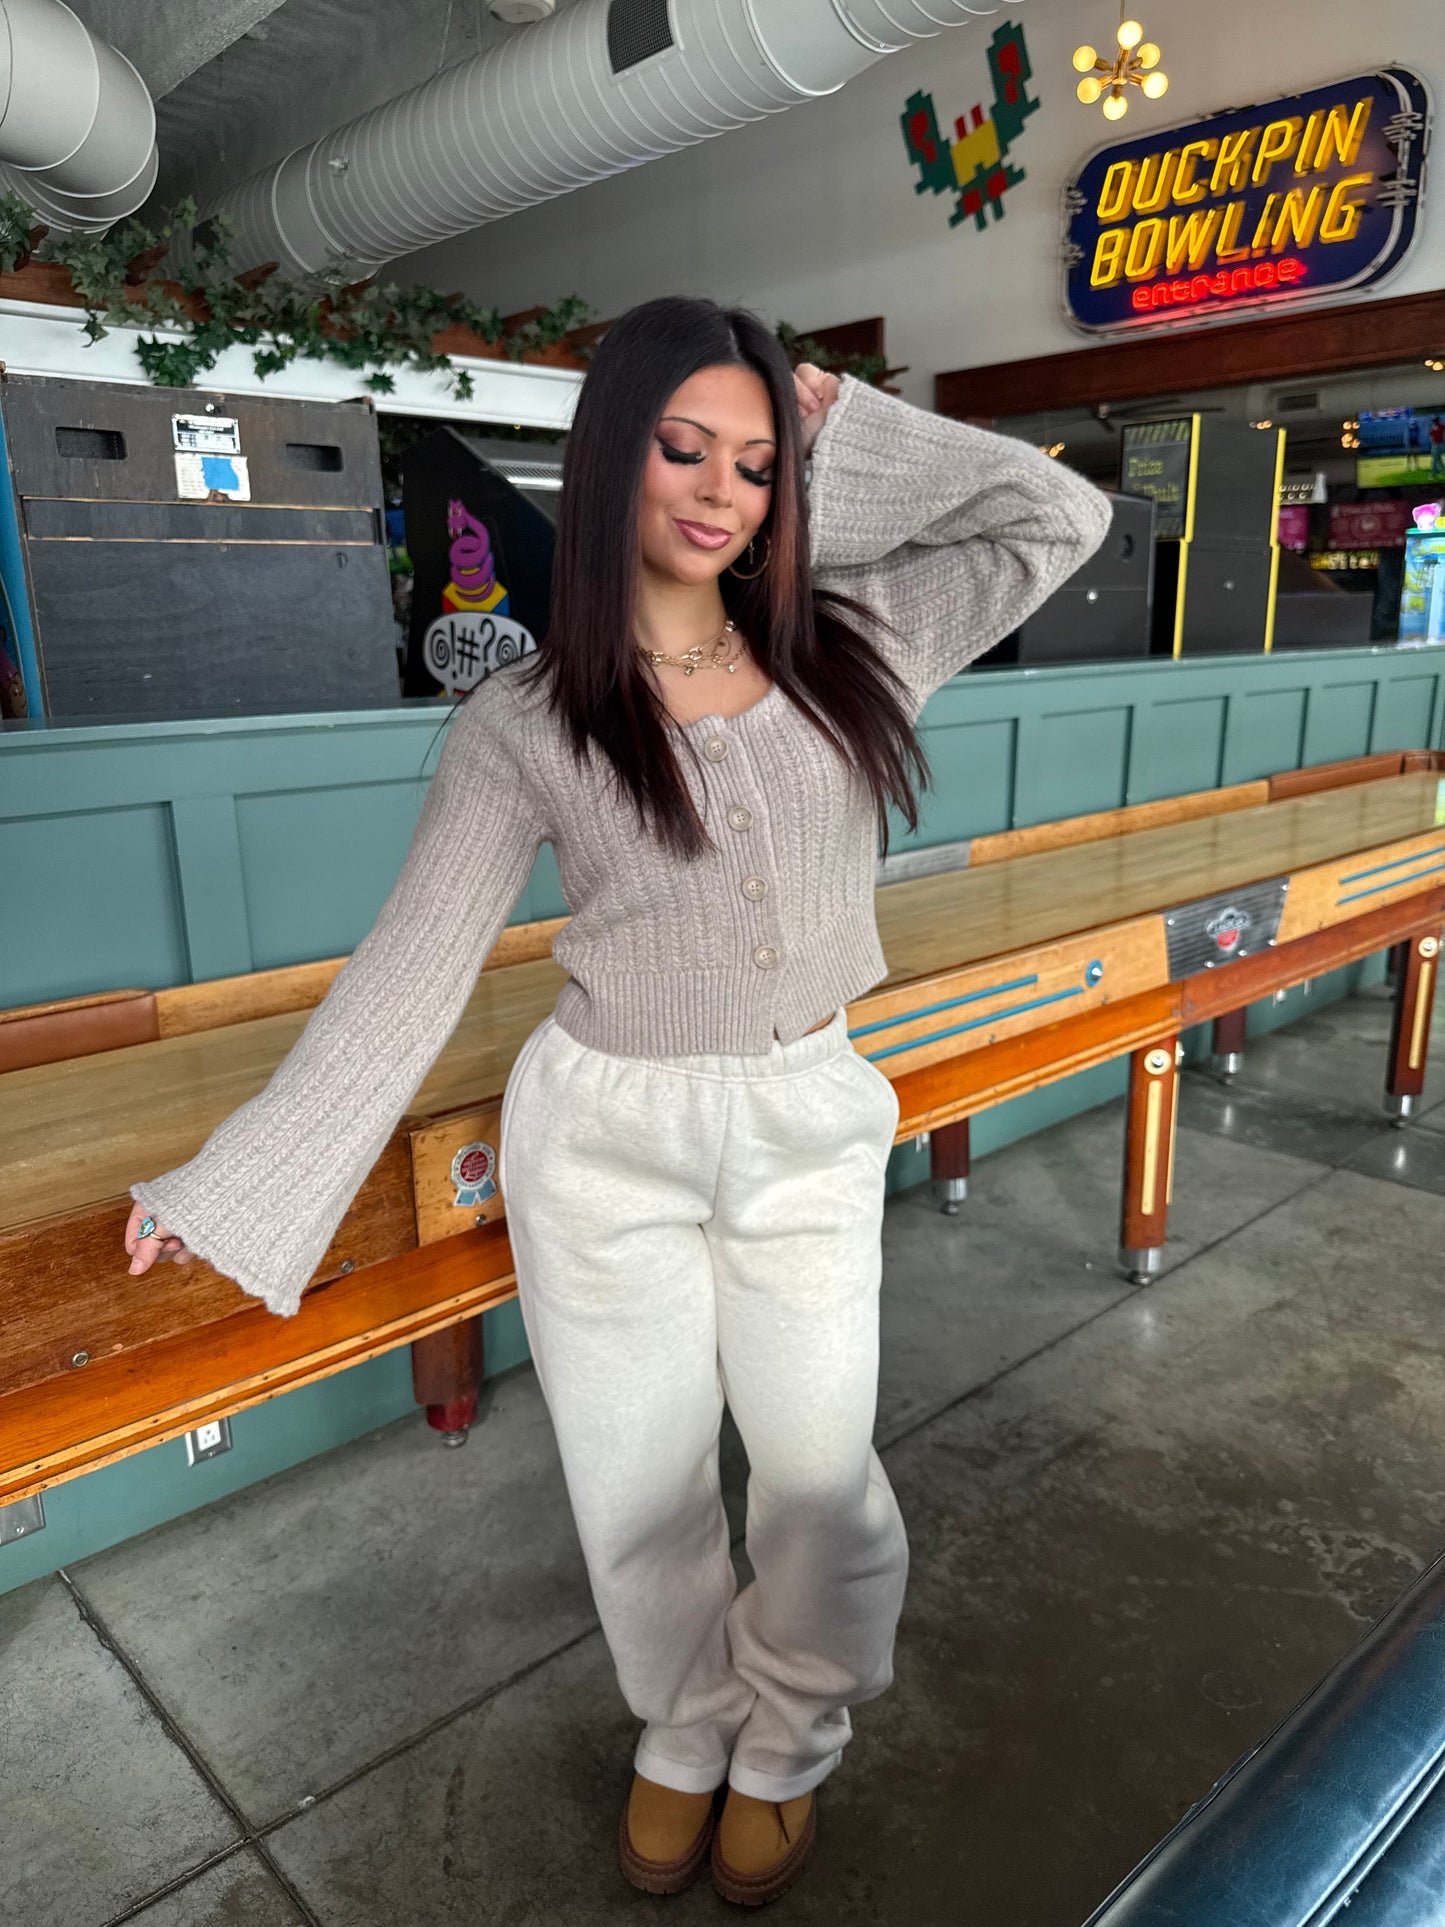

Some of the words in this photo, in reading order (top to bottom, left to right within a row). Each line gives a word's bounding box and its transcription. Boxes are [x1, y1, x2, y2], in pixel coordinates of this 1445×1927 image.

[1097, 97, 1373, 224] DUCKPIN
[1090, 174, 1373, 289] BOWLING
[1132, 258, 1304, 309] entrance
